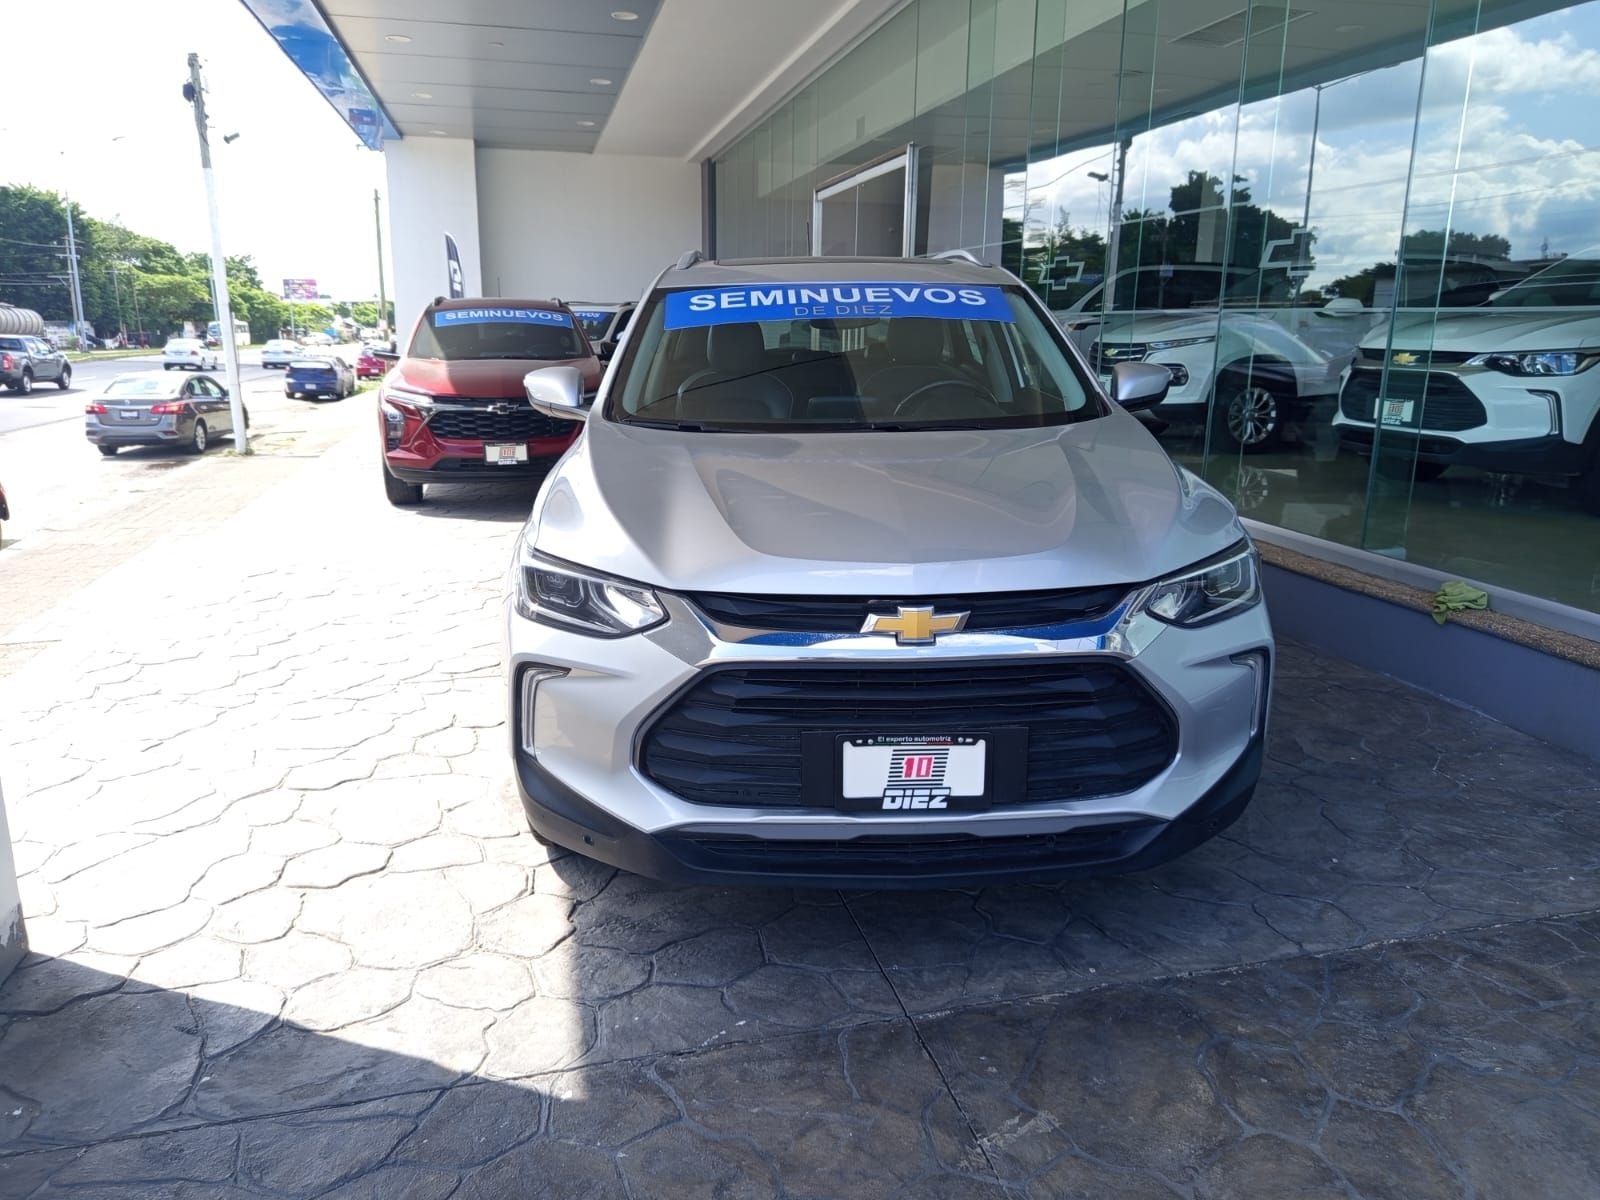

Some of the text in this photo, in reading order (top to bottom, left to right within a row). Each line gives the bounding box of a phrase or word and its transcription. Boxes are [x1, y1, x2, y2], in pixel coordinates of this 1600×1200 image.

[688, 287, 987, 312] SEMINUEVOS
[795, 304, 893, 316] DE DIEZ
[445, 310, 563, 321] SEMINUEVOS
[904, 756, 933, 778] 10
[882, 788, 951, 810] DIEZ
